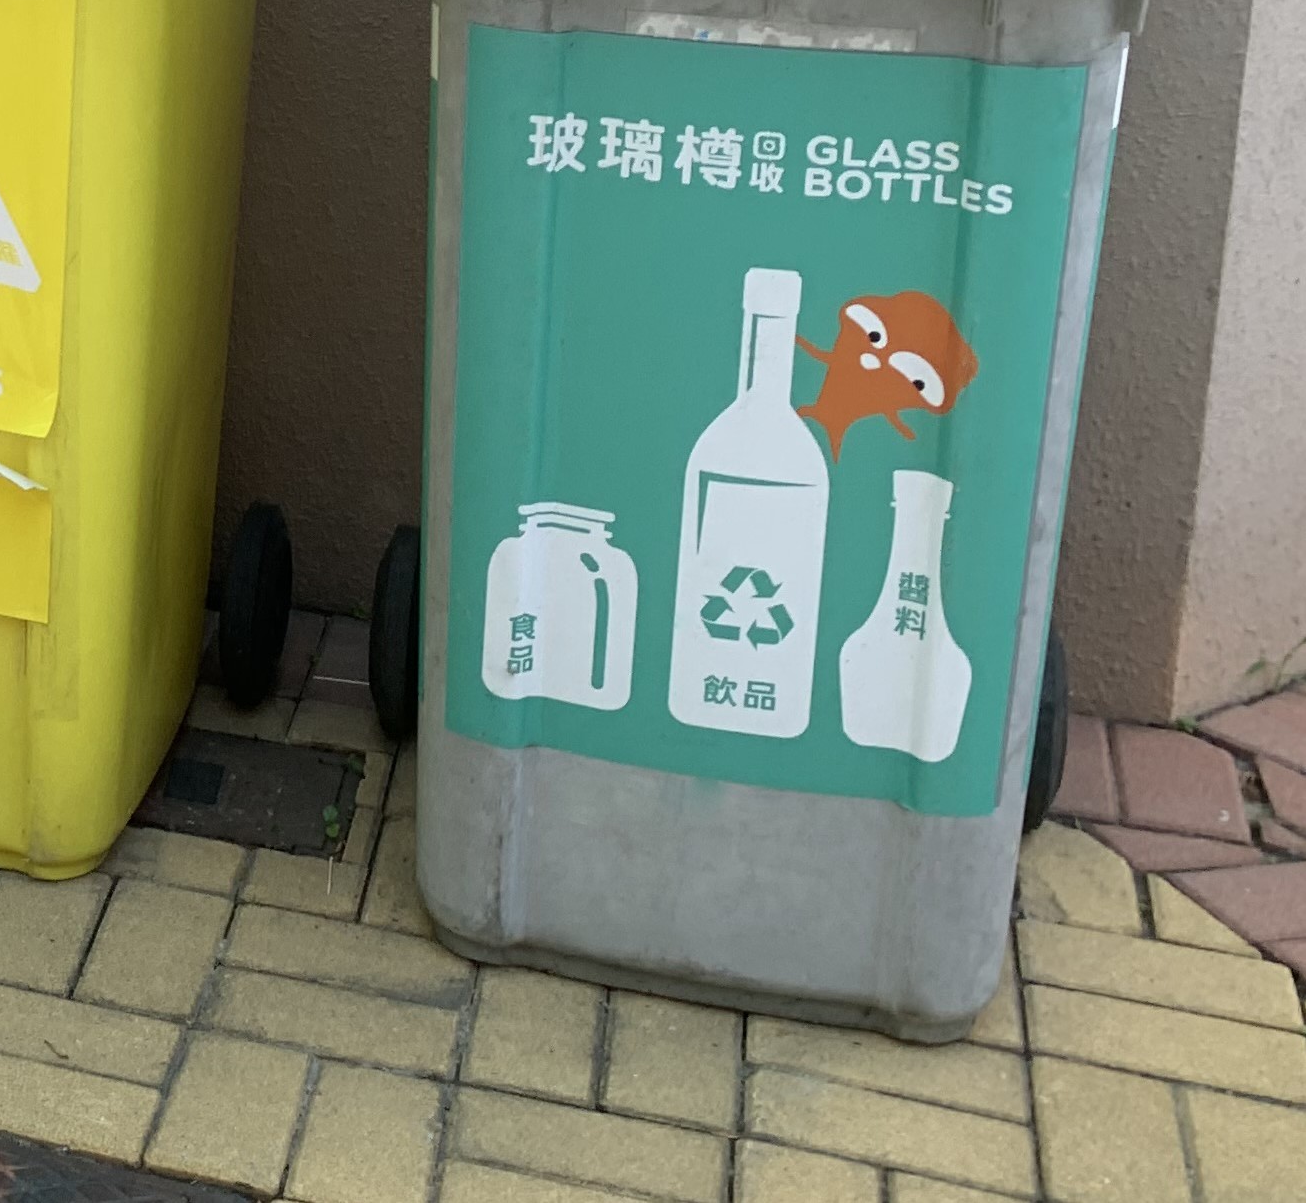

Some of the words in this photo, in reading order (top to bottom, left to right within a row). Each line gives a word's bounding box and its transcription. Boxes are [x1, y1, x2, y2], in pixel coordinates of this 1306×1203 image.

[805, 134, 960, 173] GLASS
[804, 167, 1014, 215] BOTTLES
[894, 572, 930, 640] 醬料
[506, 612, 537, 675] 食品
[702, 674, 776, 711] 飲品
